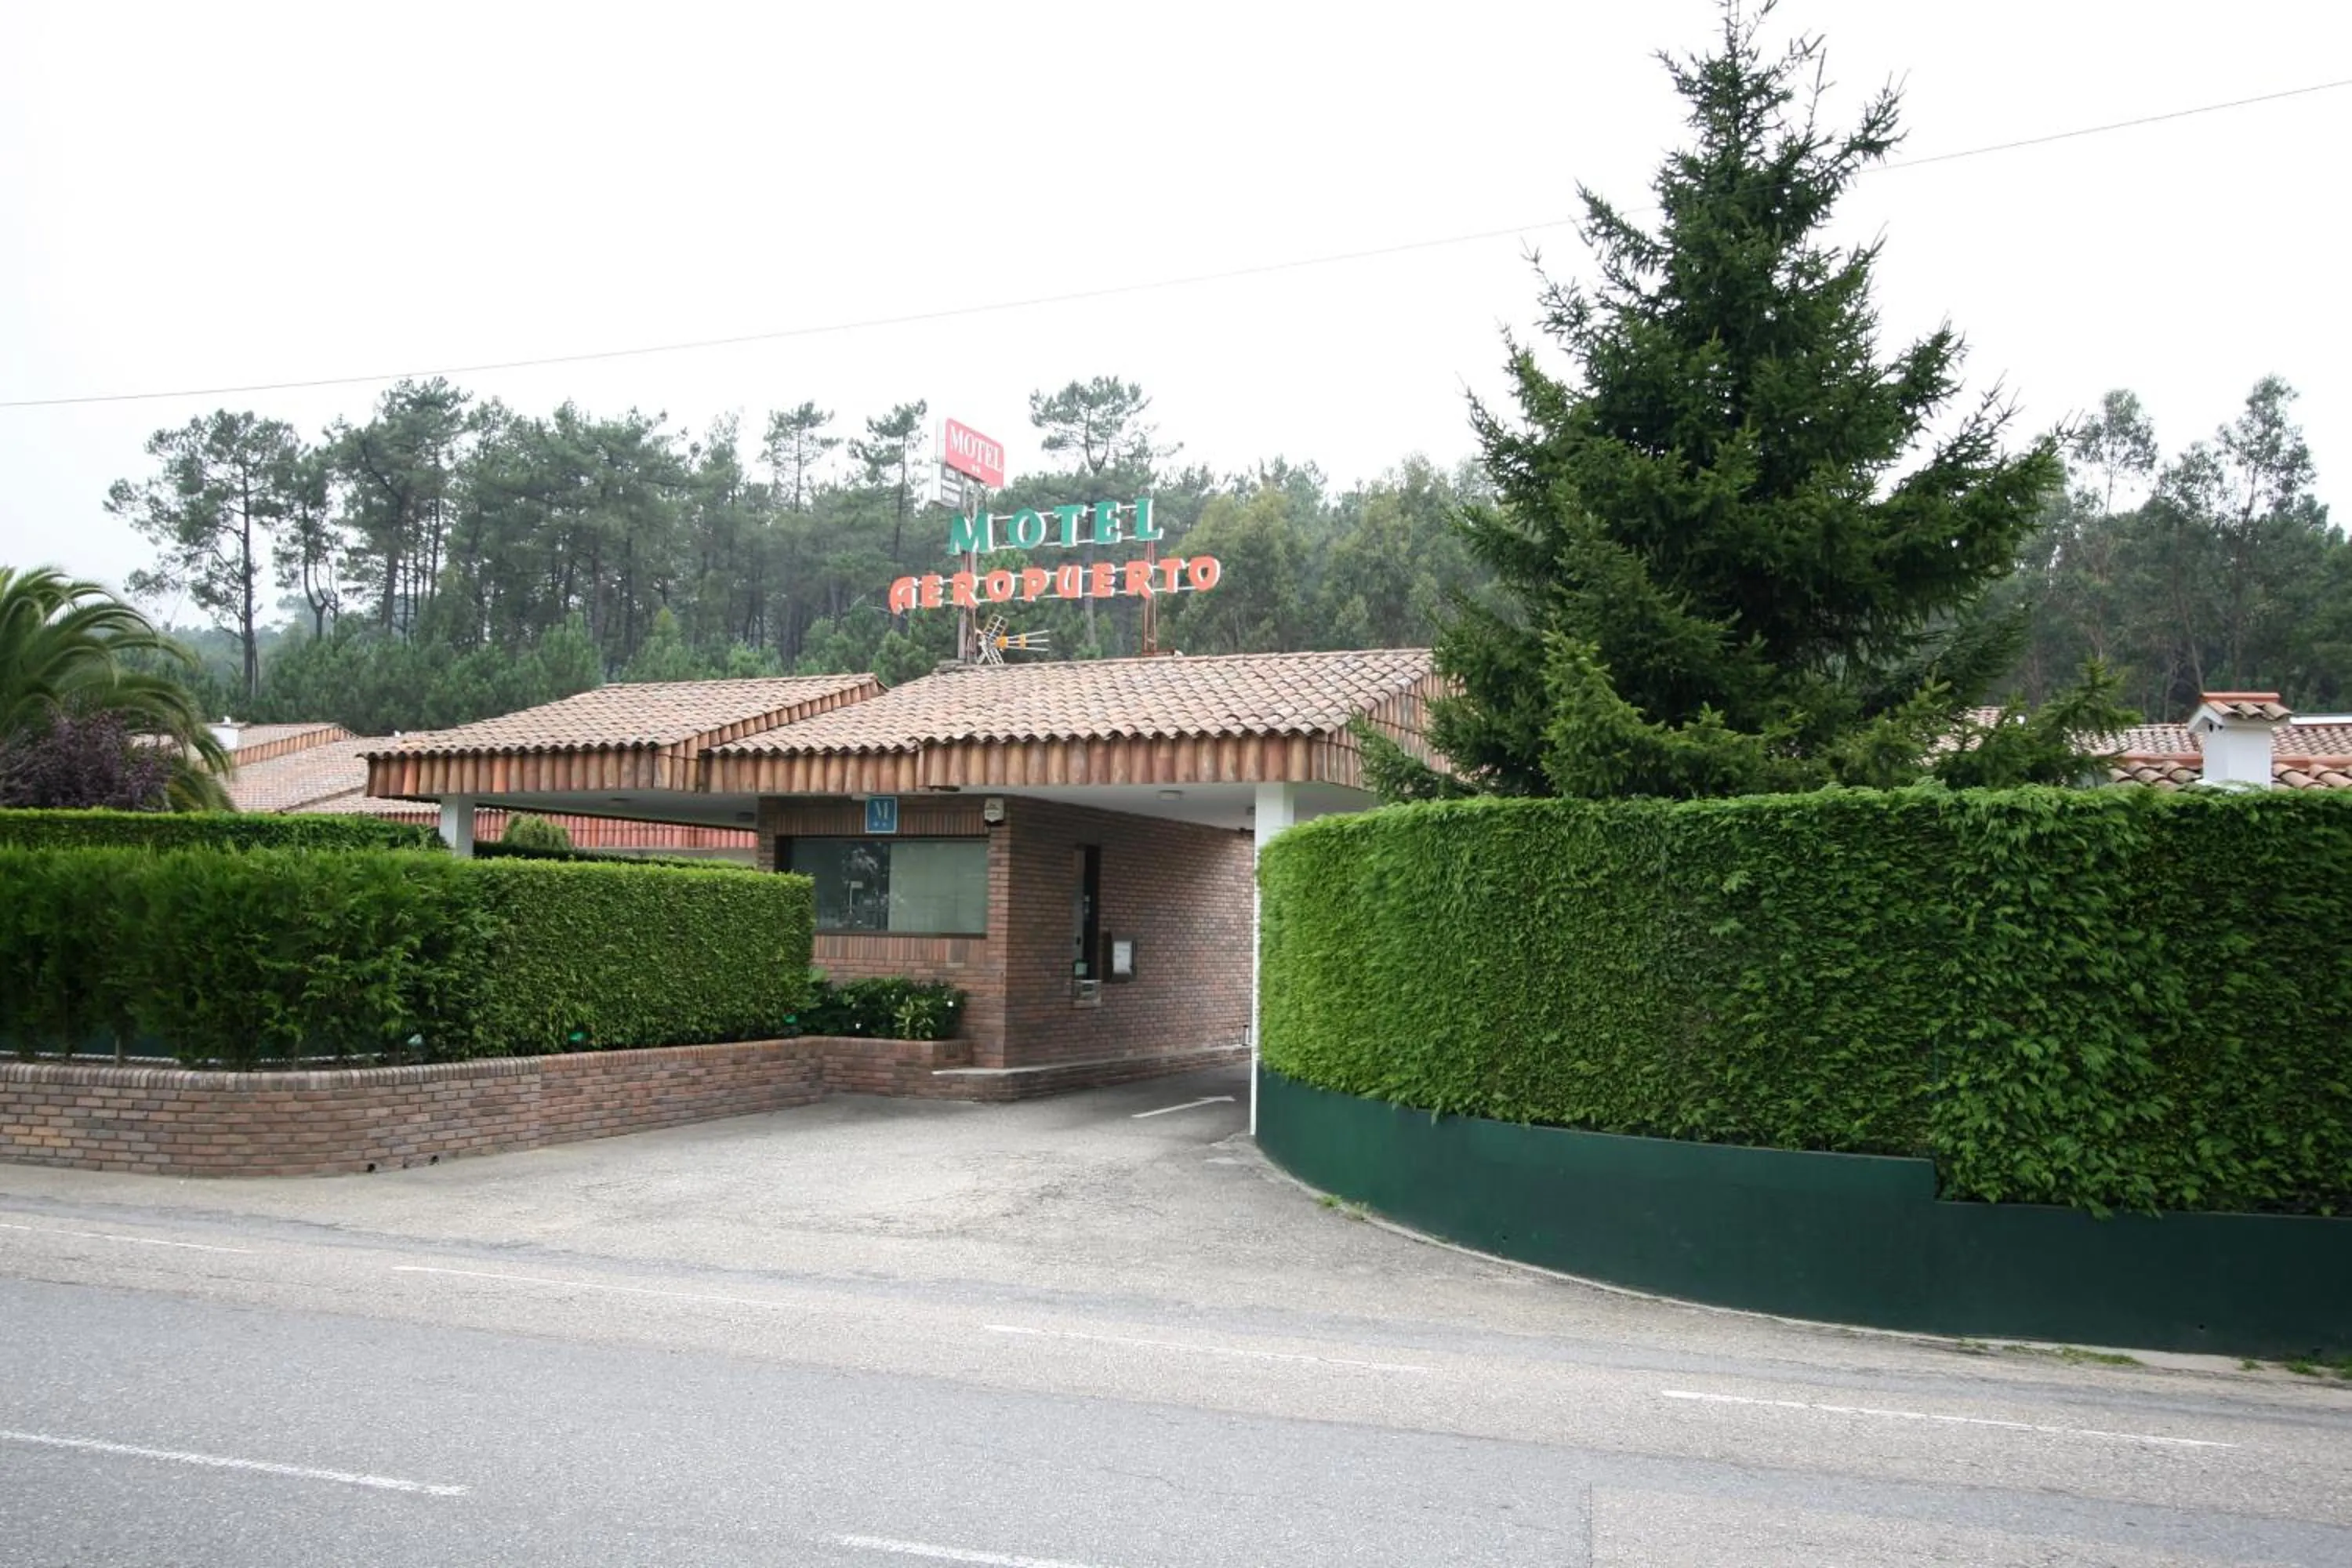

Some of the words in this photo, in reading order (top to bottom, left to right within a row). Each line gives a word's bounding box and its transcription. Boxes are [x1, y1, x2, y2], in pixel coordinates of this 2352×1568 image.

[949, 424, 1004, 472] MOTEL
[946, 498, 1163, 555] MOTEL
[888, 555, 1221, 615] AEROPUERTO
[873, 800, 891, 820] M
